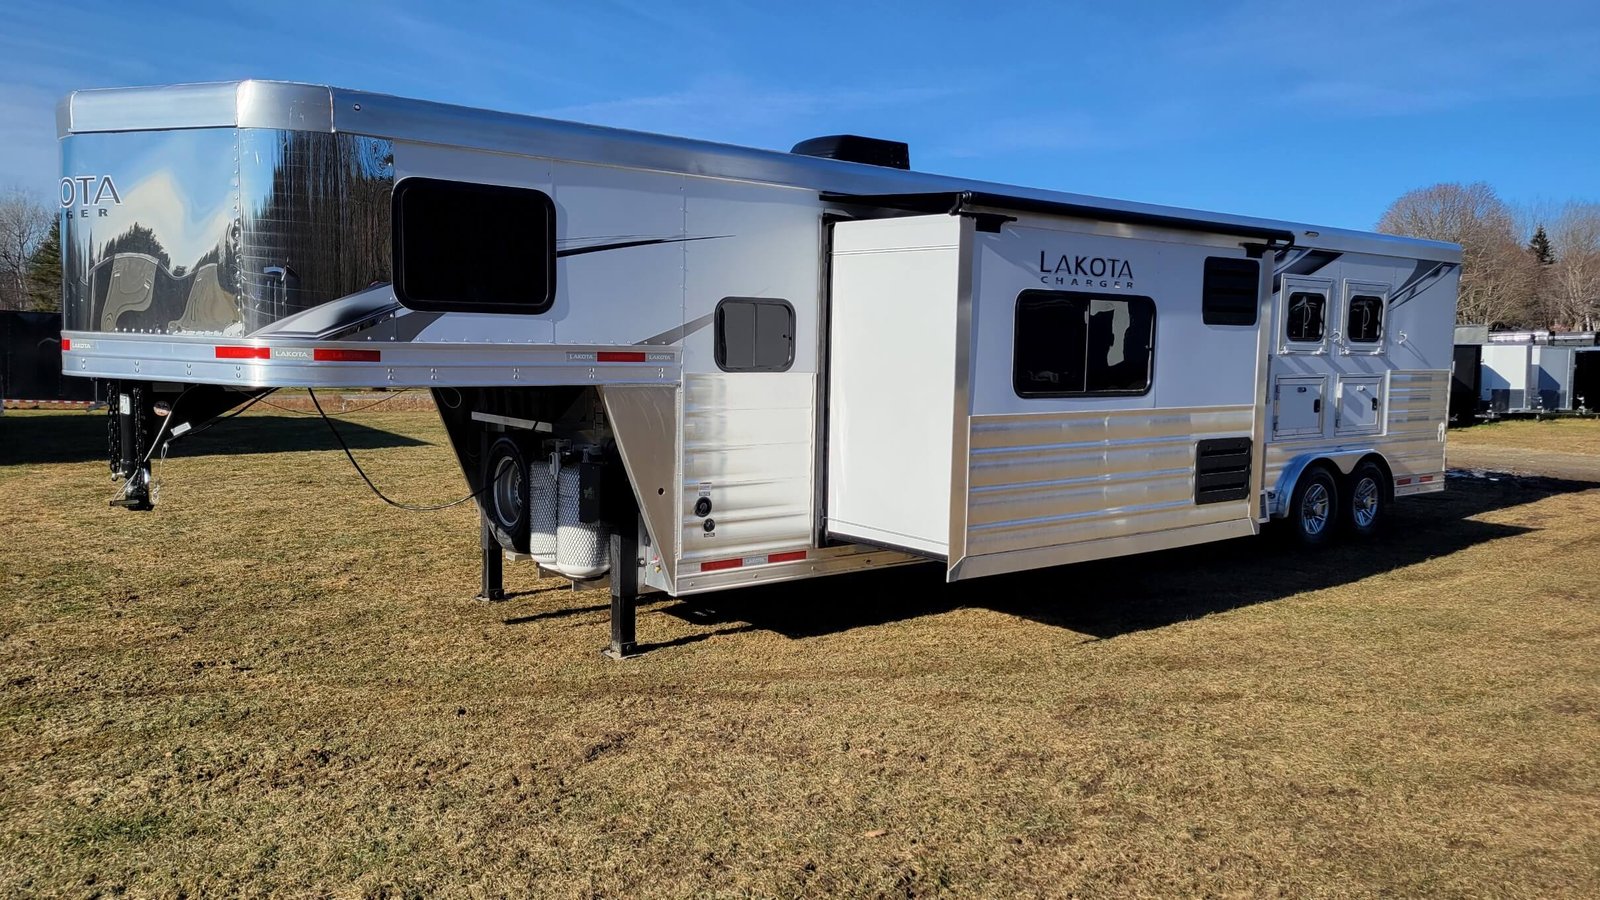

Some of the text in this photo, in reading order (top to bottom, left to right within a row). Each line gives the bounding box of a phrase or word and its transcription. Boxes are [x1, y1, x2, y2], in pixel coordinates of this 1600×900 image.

[1040, 250, 1133, 279] LAKOTA
[1040, 276, 1133, 289] CHARGER
[275, 350, 308, 358] LAKOTA
